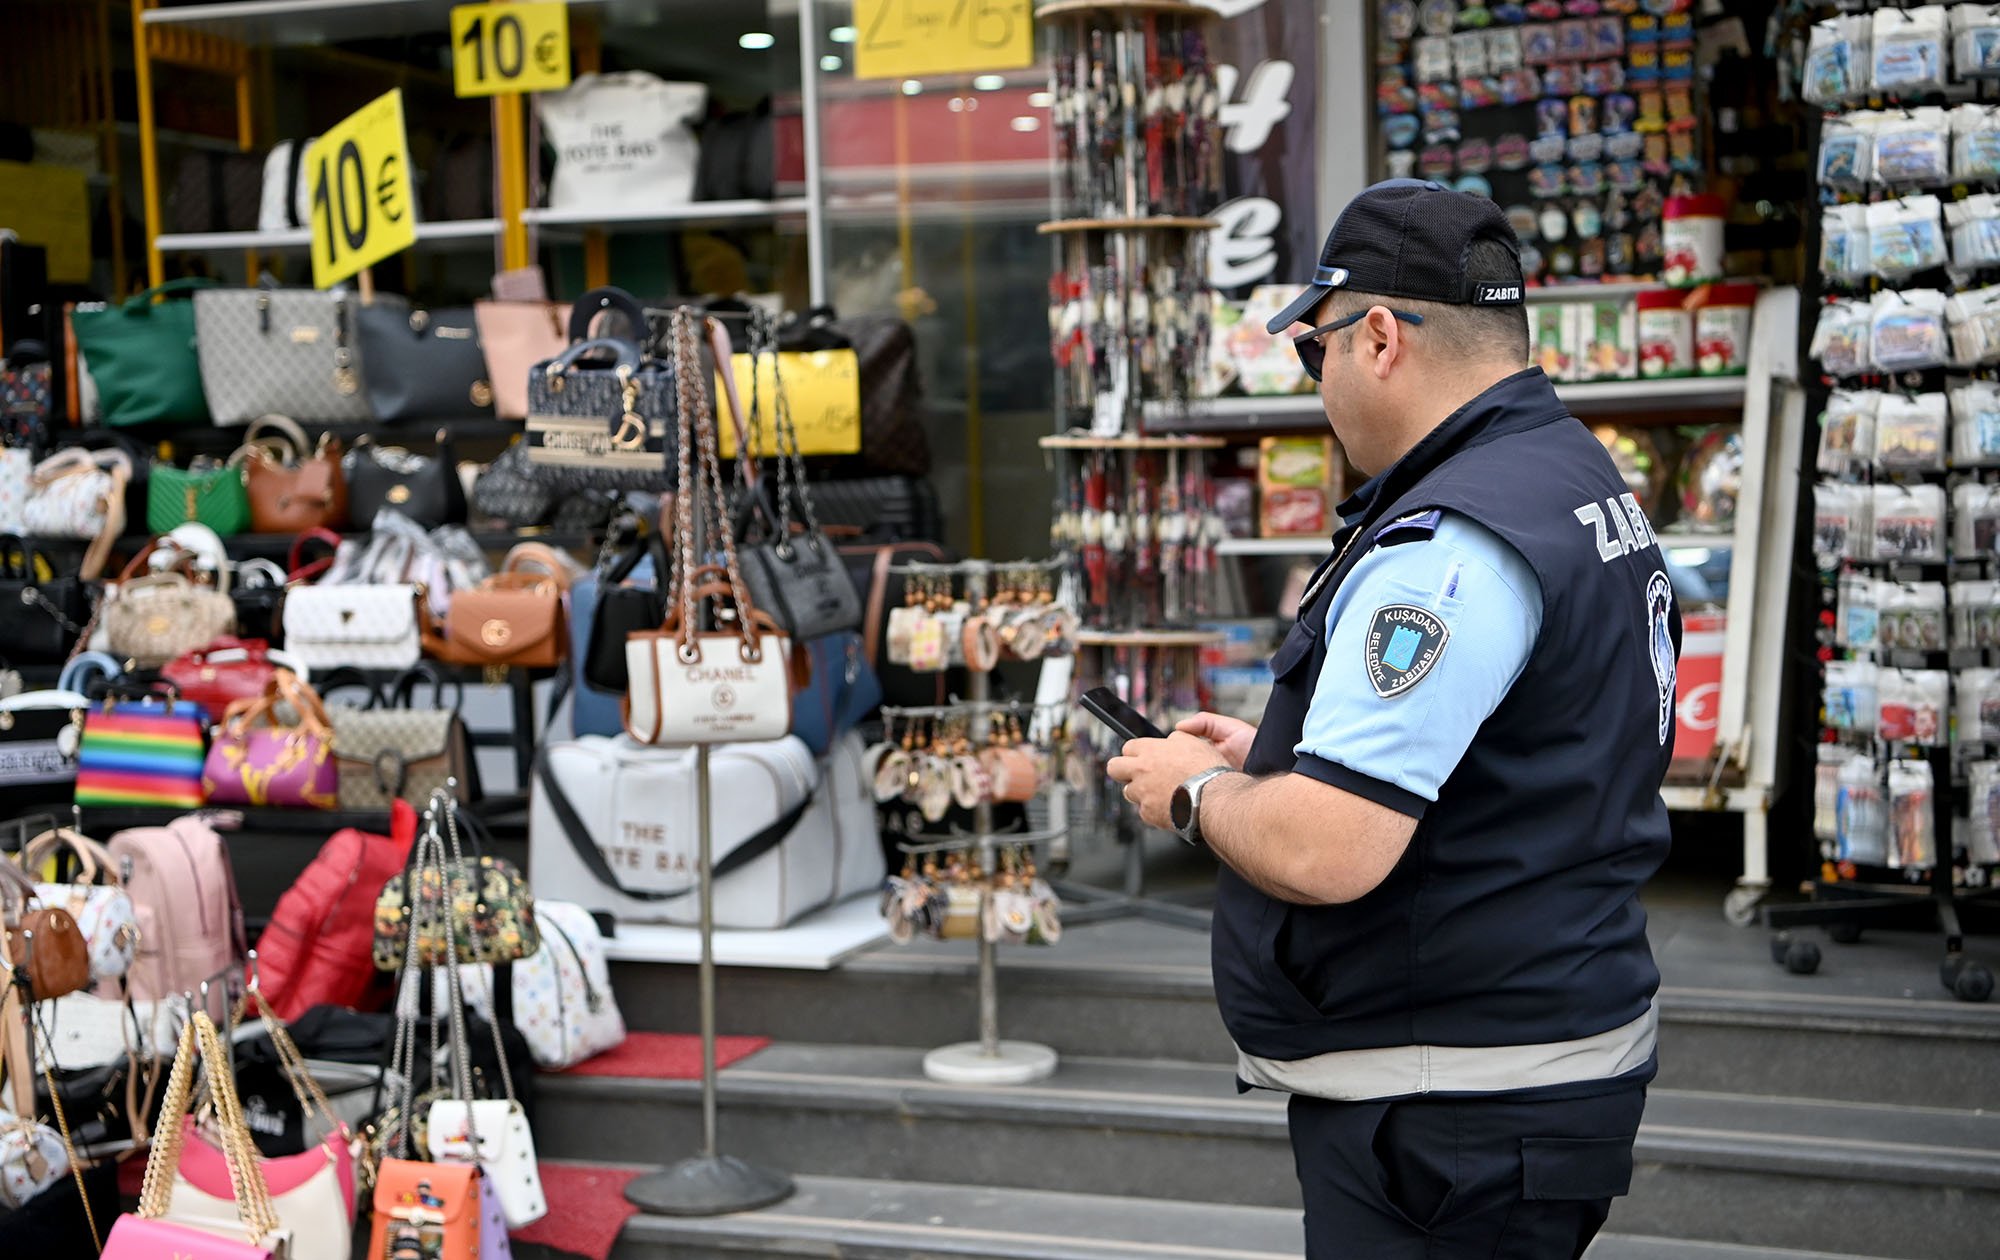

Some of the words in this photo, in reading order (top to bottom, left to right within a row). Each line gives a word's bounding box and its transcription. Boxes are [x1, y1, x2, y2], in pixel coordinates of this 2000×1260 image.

[1484, 287, 1520, 301] ZABITA
[1384, 609, 1440, 637] KUŞADASI
[1369, 632, 1387, 684] BELEDİYE
[1391, 648, 1434, 688] ZABITASI
[686, 666, 756, 683] CHANEL
[621, 821, 666, 844] THE
